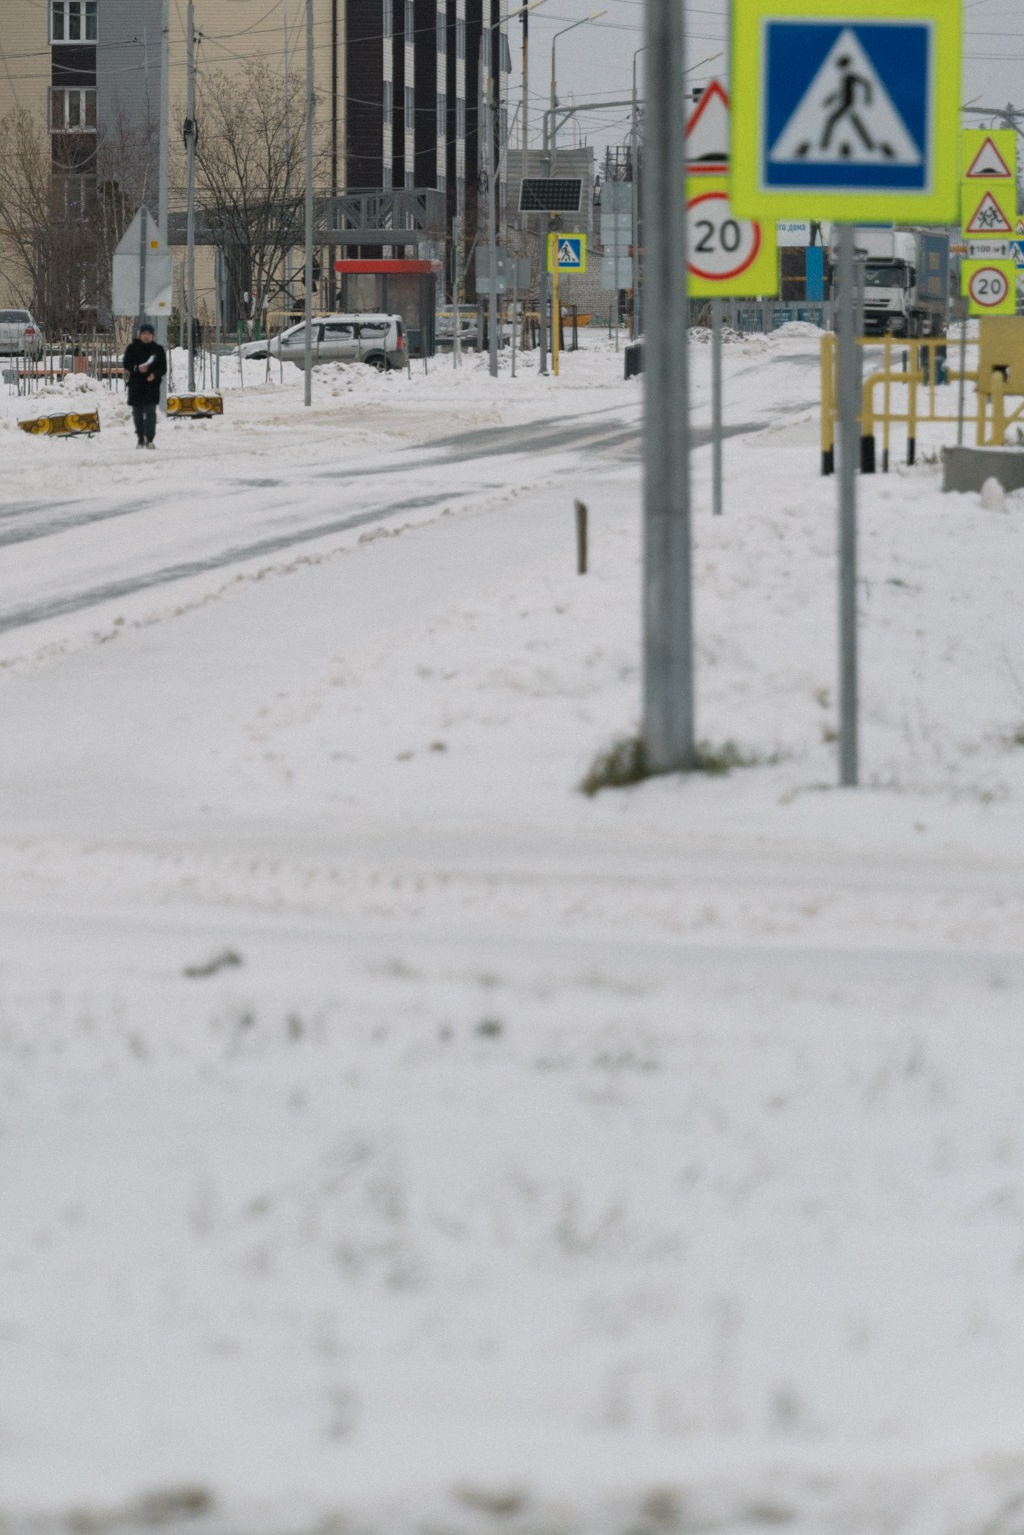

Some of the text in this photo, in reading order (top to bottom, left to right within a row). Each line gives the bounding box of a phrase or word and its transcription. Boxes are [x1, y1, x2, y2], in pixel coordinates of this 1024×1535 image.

[695, 219, 740, 252] 20
[976, 245, 991, 253] 100
[978, 279, 1001, 295] 20
